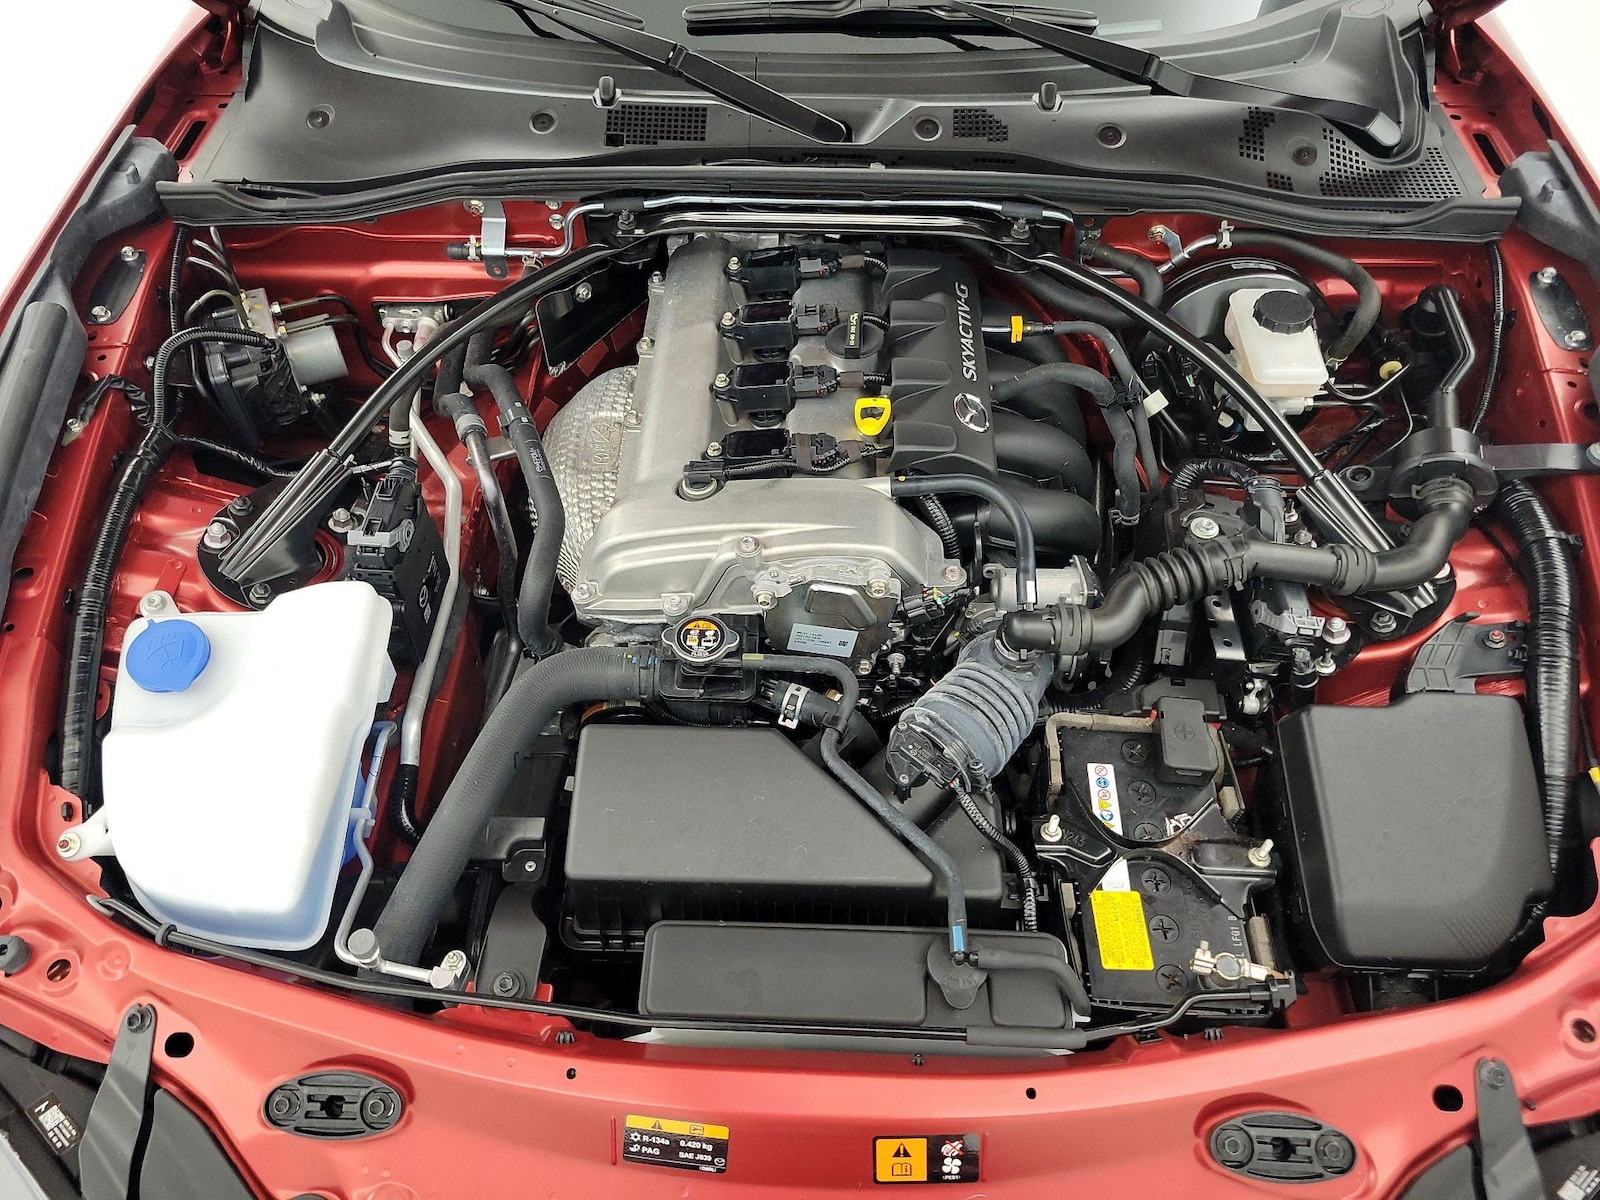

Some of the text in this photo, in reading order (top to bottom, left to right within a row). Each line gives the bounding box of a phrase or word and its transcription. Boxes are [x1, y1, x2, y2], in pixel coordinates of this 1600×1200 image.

[955, 282, 977, 382] SKYACTIV-G
[642, 1135, 713, 1152] R-134a 0.420 kg
[642, 1146, 660, 1155] PAG
[678, 1151, 694, 1160] SAE
